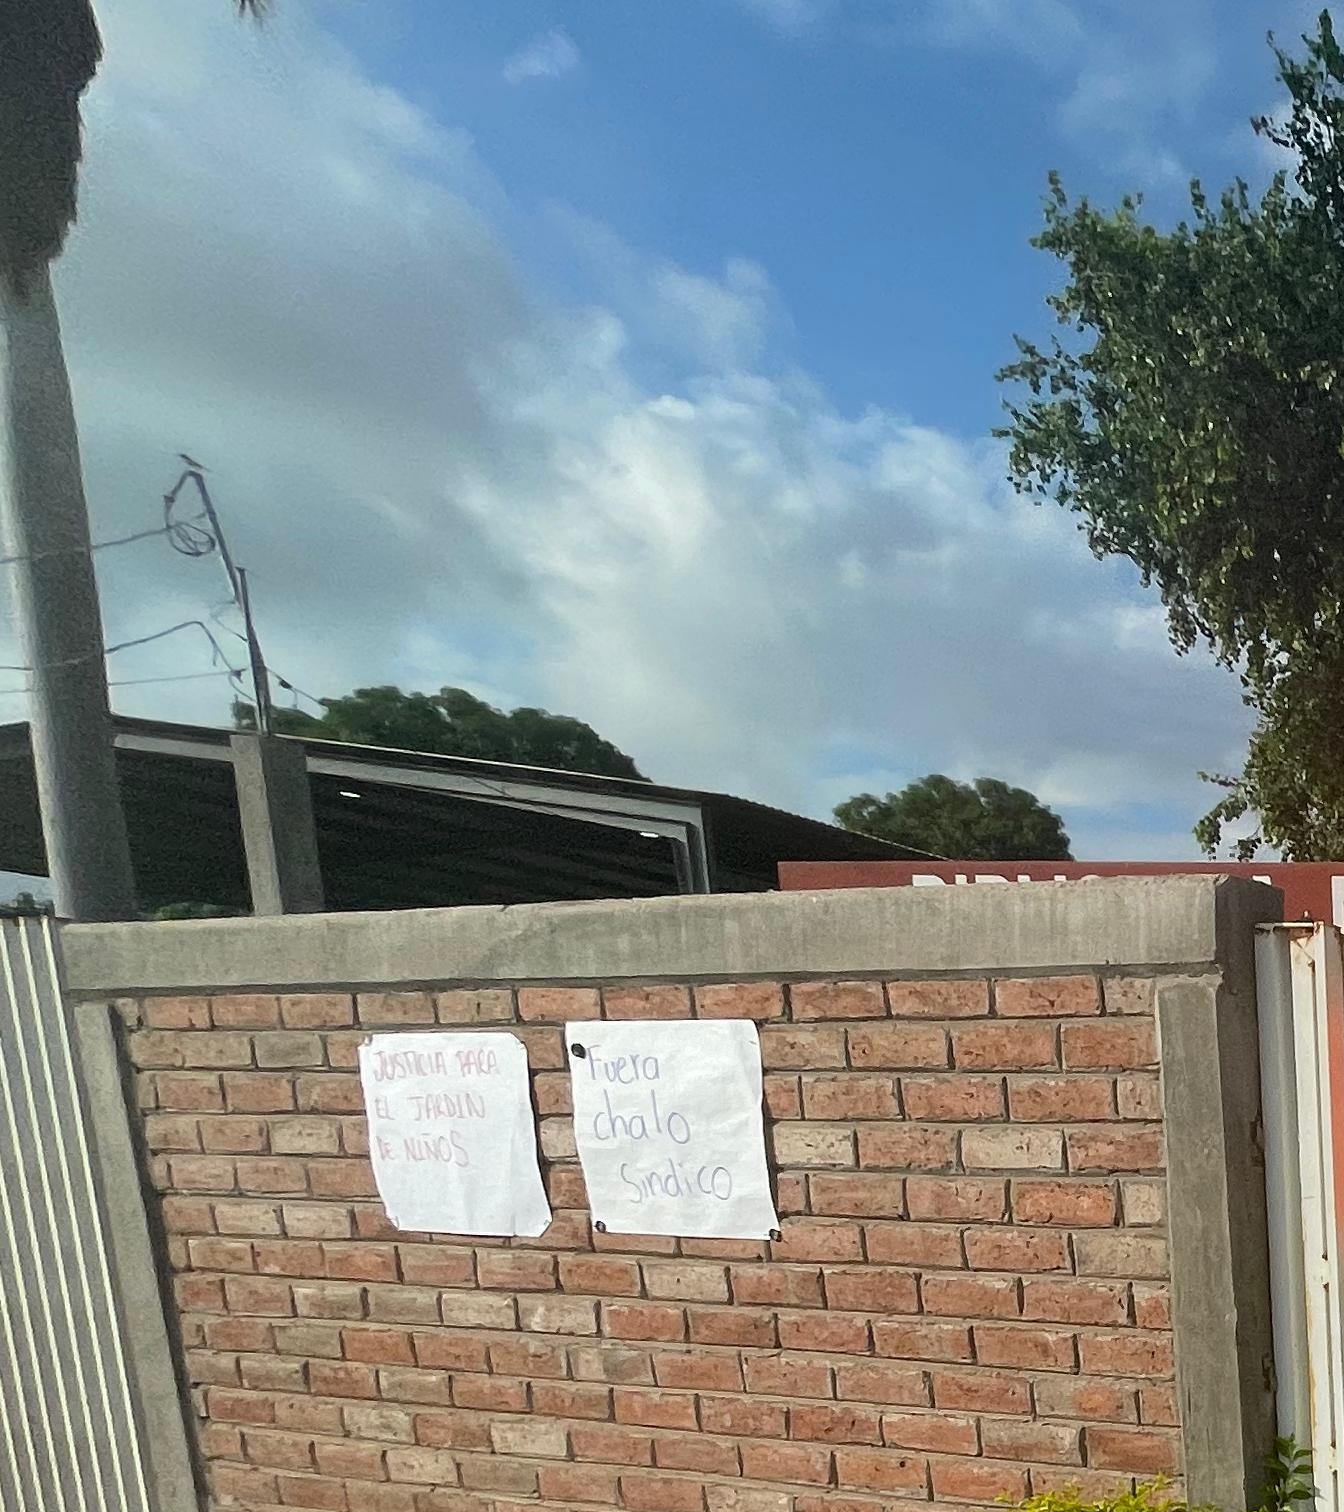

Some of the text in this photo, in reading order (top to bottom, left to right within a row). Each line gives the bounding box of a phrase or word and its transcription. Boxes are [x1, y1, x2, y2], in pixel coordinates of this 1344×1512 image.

[373, 1050, 448, 1081] JUSTICIA
[587, 1045, 660, 1084] Fuera
[374, 1093, 485, 1121] EL JARDIN
[404, 1130, 470, 1168] NIÑOS
